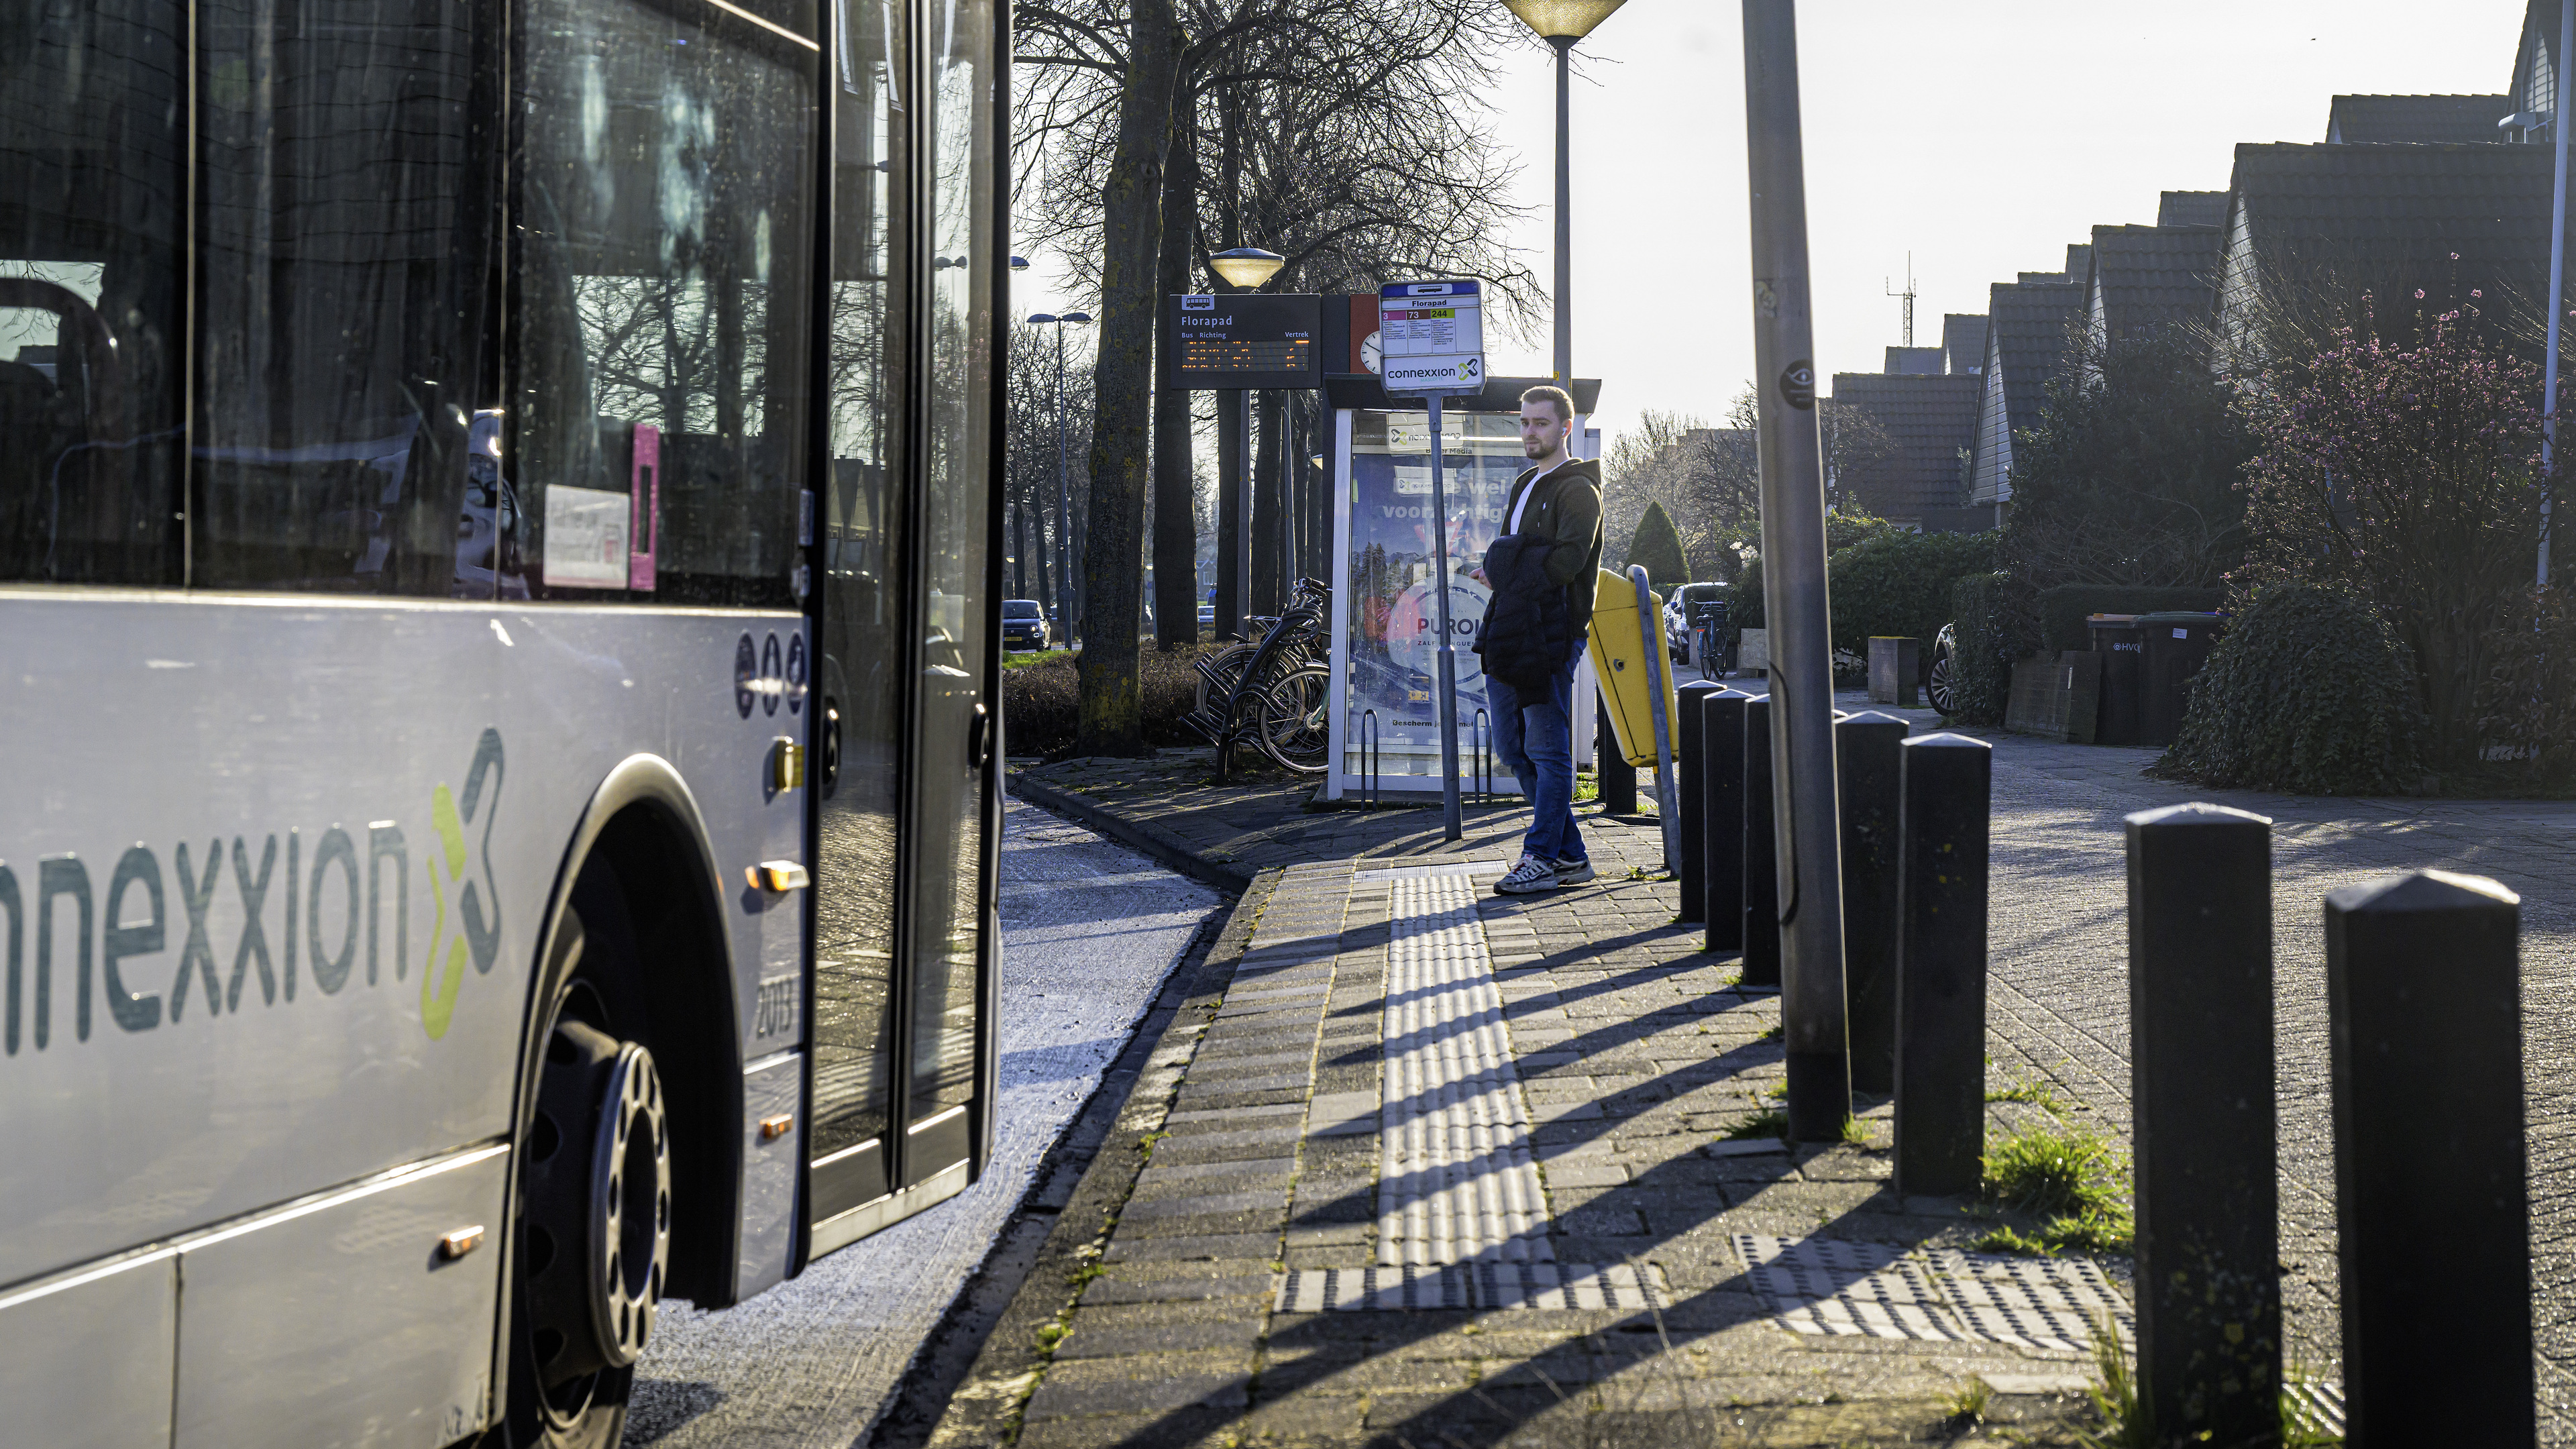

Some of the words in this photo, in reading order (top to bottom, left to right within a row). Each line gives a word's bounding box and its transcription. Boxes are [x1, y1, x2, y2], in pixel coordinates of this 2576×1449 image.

[1411, 299, 1447, 307] Florapad
[1432, 310, 1448, 318] 244
[1181, 315, 1232, 328] Florapad
[1388, 368, 1456, 378] connexxion
[1468, 479, 1506, 495] wel
